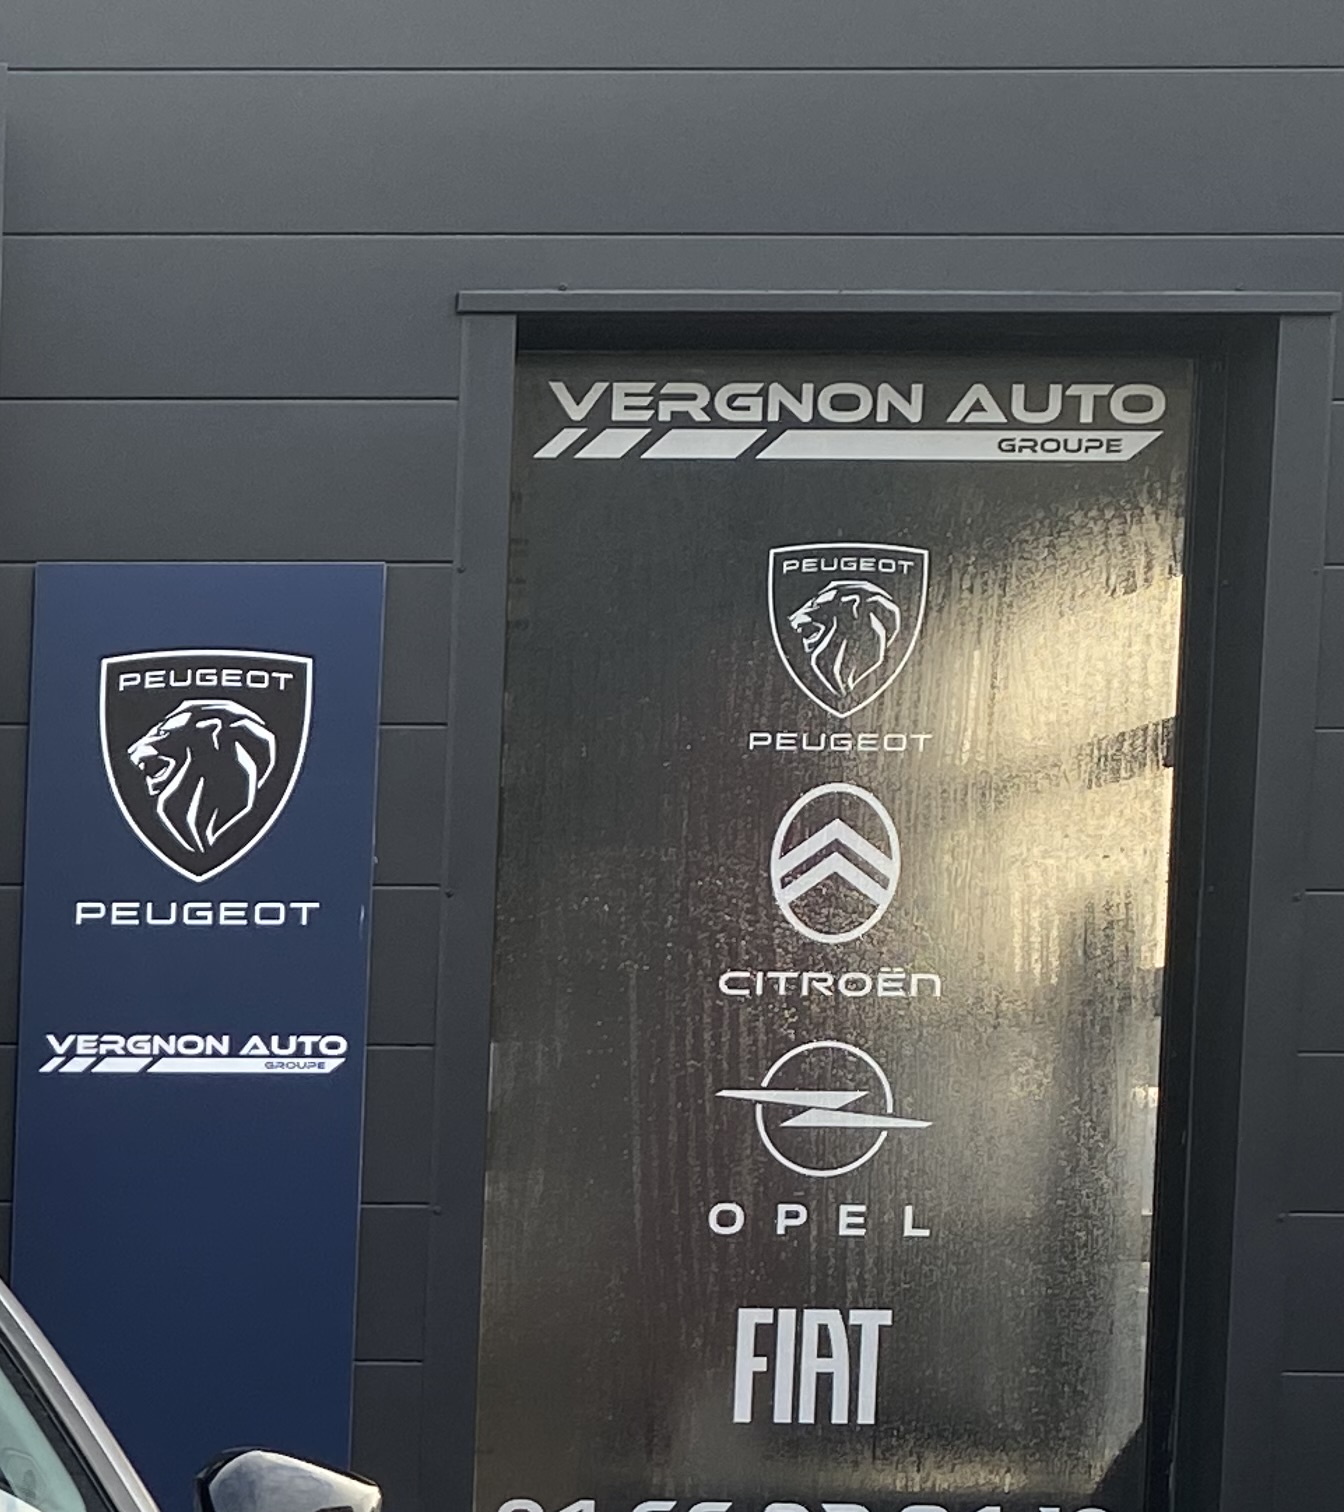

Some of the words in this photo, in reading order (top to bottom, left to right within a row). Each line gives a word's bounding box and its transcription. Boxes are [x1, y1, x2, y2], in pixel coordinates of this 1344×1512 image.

[548, 382, 923, 423] VERGNON
[947, 383, 1166, 424] AUTO
[997, 437, 1123, 454] GROUPE
[782, 557, 914, 575] PEUGEOT
[119, 669, 293, 691] PEUGEOT
[748, 732, 932, 752] PEUGEOT
[75, 902, 320, 926] PEUGEOT
[719, 967, 942, 999] CITROËN
[46, 1034, 229, 1055] VERGNON
[239, 1036, 348, 1056] AUTO
[264, 1061, 326, 1070] GROUPE
[709, 1203, 930, 1237] OPEL
[732, 1307, 893, 1425] FIAT
